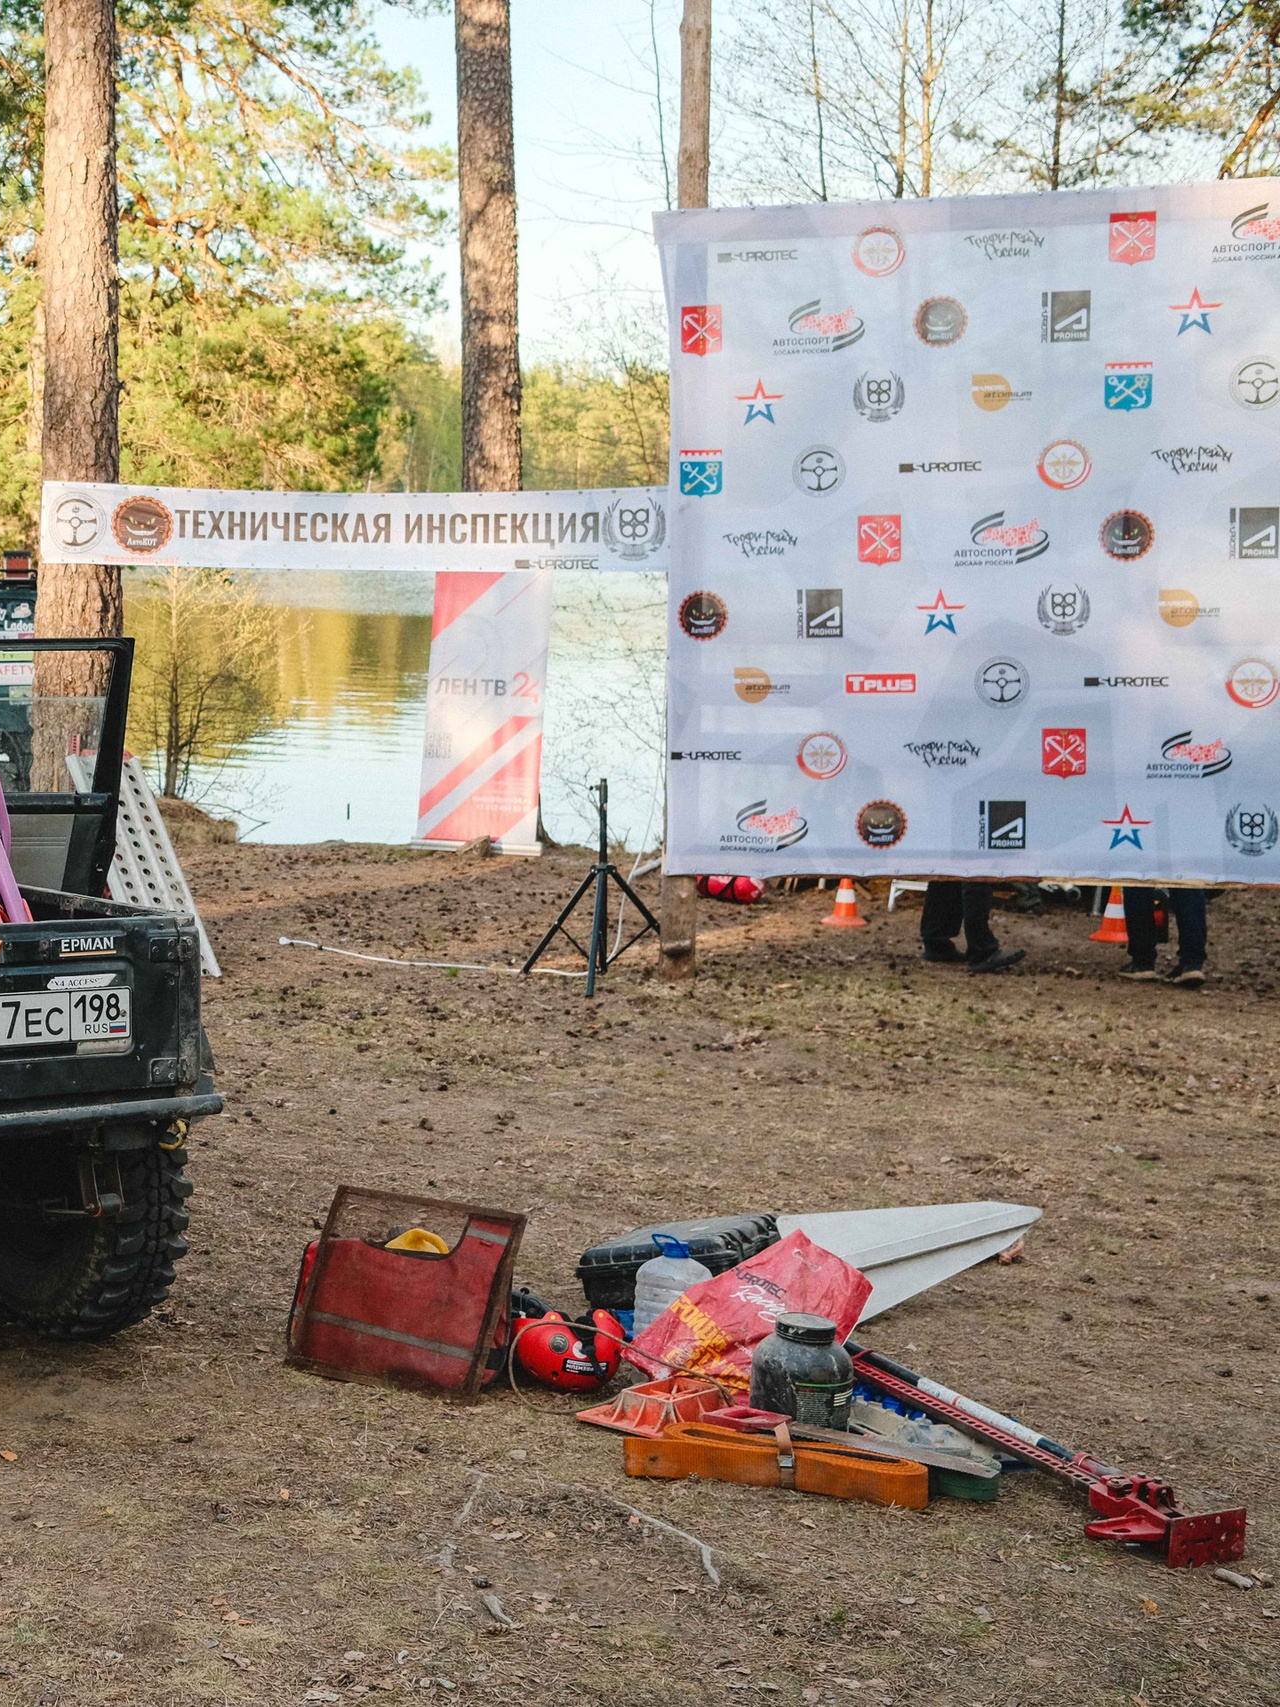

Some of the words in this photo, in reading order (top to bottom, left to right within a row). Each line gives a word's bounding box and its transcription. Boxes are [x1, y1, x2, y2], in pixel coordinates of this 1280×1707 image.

[1212, 242, 1276, 254] АВТОСПОРТ
[1244, 253, 1276, 261] РОССИИ
[1053, 331, 1087, 340] PROHIM
[772, 336, 830, 347] АВТОСПОРТ
[913, 460, 982, 473] SUPROTEC
[174, 508, 391, 544] ТЕХНИЧЕСКАЯ
[404, 511, 600, 550] ИНСПЕКЦИЯ
[953, 549, 1014, 558] АВТОСПОРТ
[1242, 548, 1276, 557] PROHIM
[808, 627, 840, 636] PROHIM
[1098, 676, 1169, 687] SUPROTEC
[681, 750, 742, 761] SUPROTEC
[1146, 763, 1200, 772] АВТОСПОРТ
[719, 834, 775, 845] АВТОСПОРТ
[990, 838, 1023, 848] PROHIM
[60, 936, 115, 953] EPMAN
[73, 992, 121, 1023] 198
[84, 1023, 109, 1035] RUS
